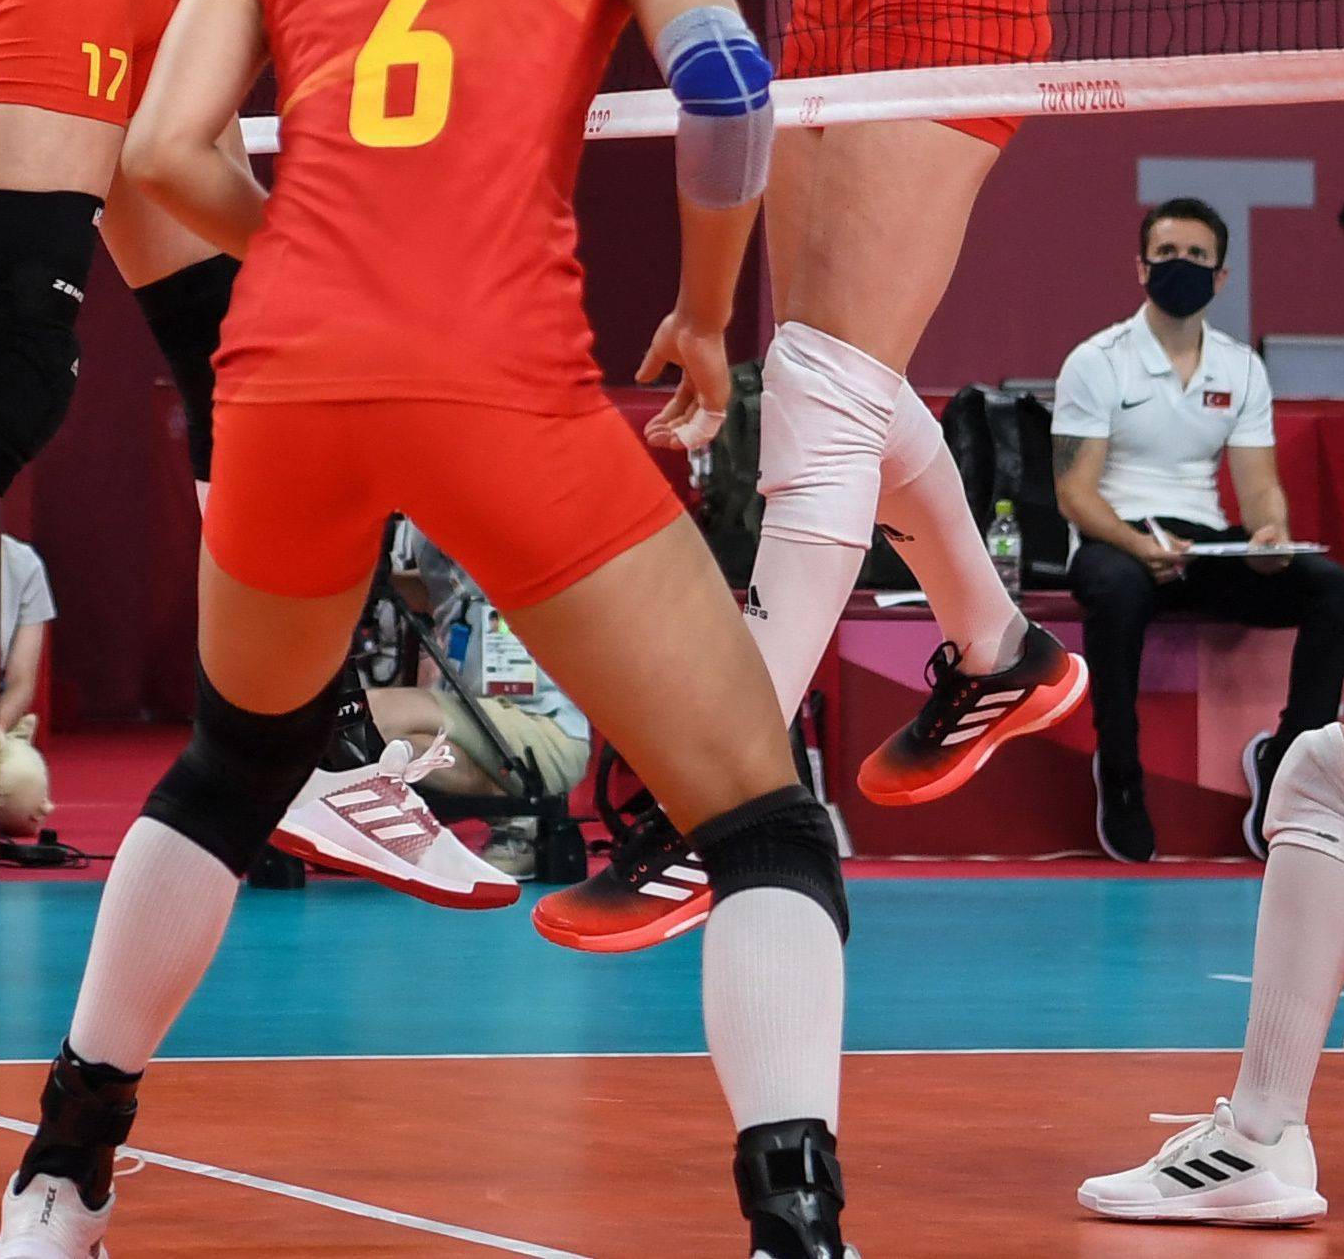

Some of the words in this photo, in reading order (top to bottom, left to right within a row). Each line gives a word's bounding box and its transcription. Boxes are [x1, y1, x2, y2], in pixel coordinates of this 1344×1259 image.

[81, 41, 128, 103] 17
[1039, 81, 1087, 111] TOKYO
[1087, 80, 1125, 109] 2020
